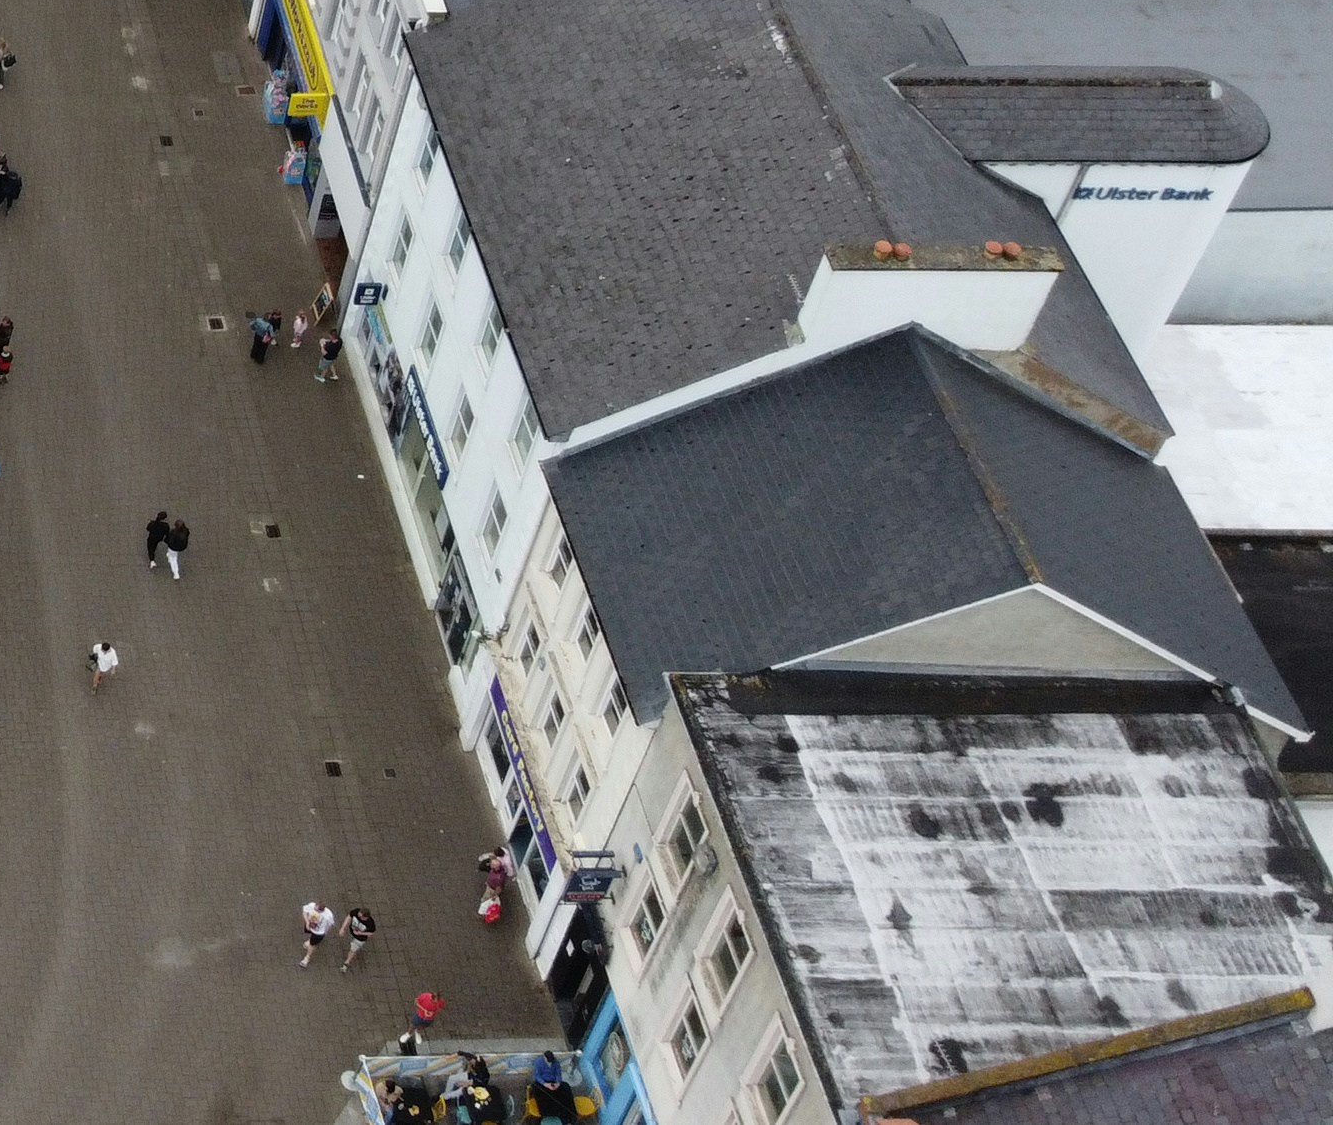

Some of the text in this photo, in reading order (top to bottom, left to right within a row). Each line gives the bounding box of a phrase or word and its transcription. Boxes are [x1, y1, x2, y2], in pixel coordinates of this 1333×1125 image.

[1096, 187, 1214, 201] Ulster Bank
[411, 389, 443, 480] Ulster Bank
[501, 709, 545, 833] Card Factory
